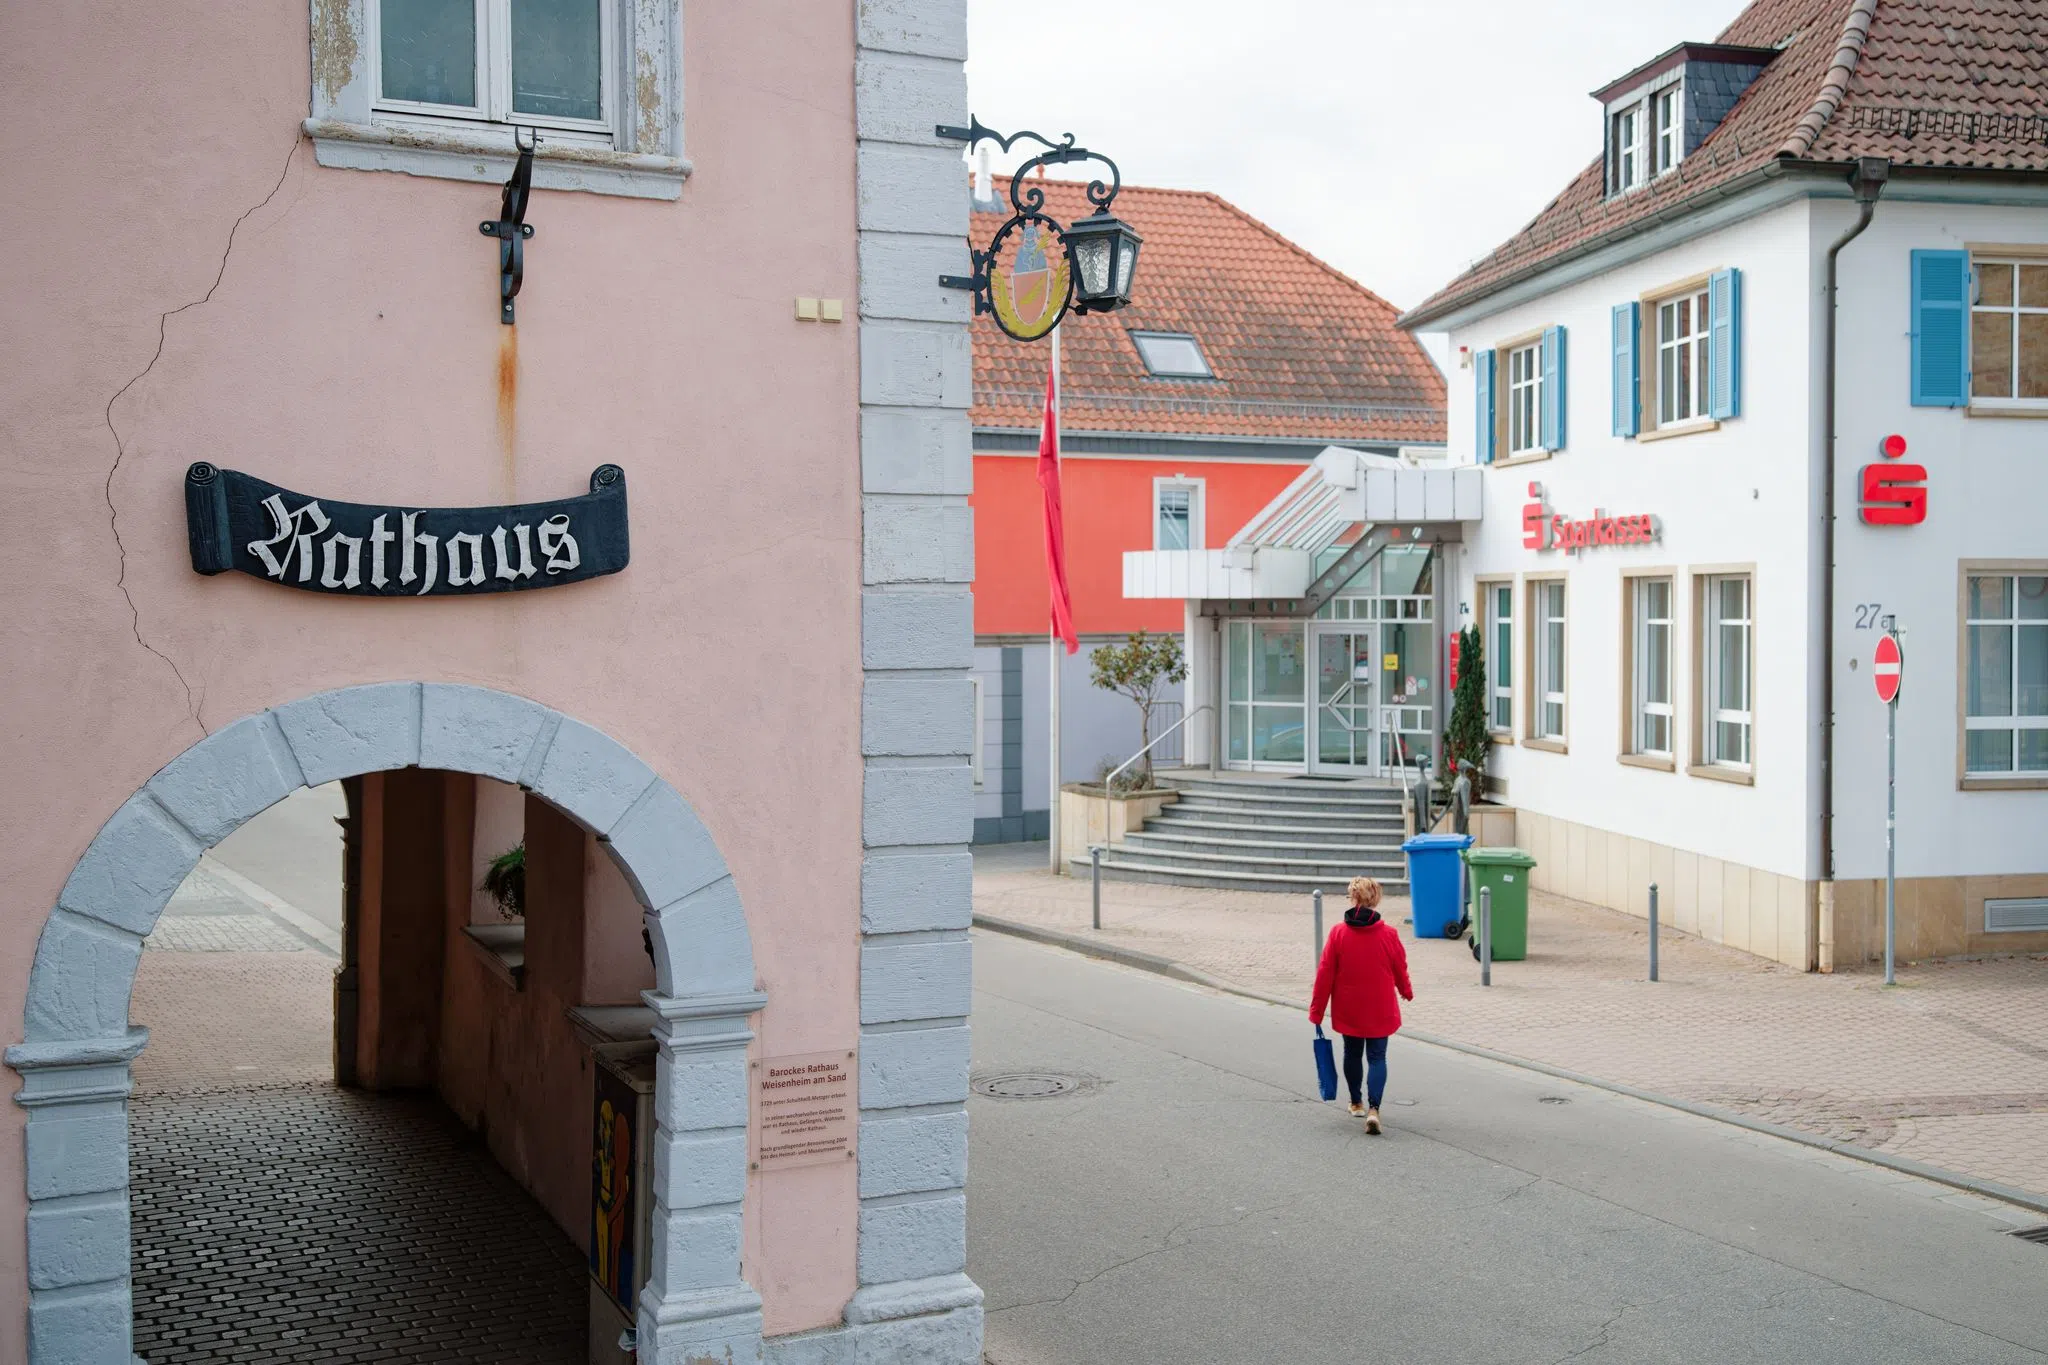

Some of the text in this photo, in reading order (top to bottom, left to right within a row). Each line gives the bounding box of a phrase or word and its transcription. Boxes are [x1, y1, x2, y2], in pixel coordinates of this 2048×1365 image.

[247, 493, 581, 596] Rathaus
[1552, 508, 1651, 555] Sparkasse
[762, 1077, 811, 1090] Weisenheim
[828, 1073, 847, 1083] Sand
[770, 1063, 839, 1077] Barockes Rathaus
